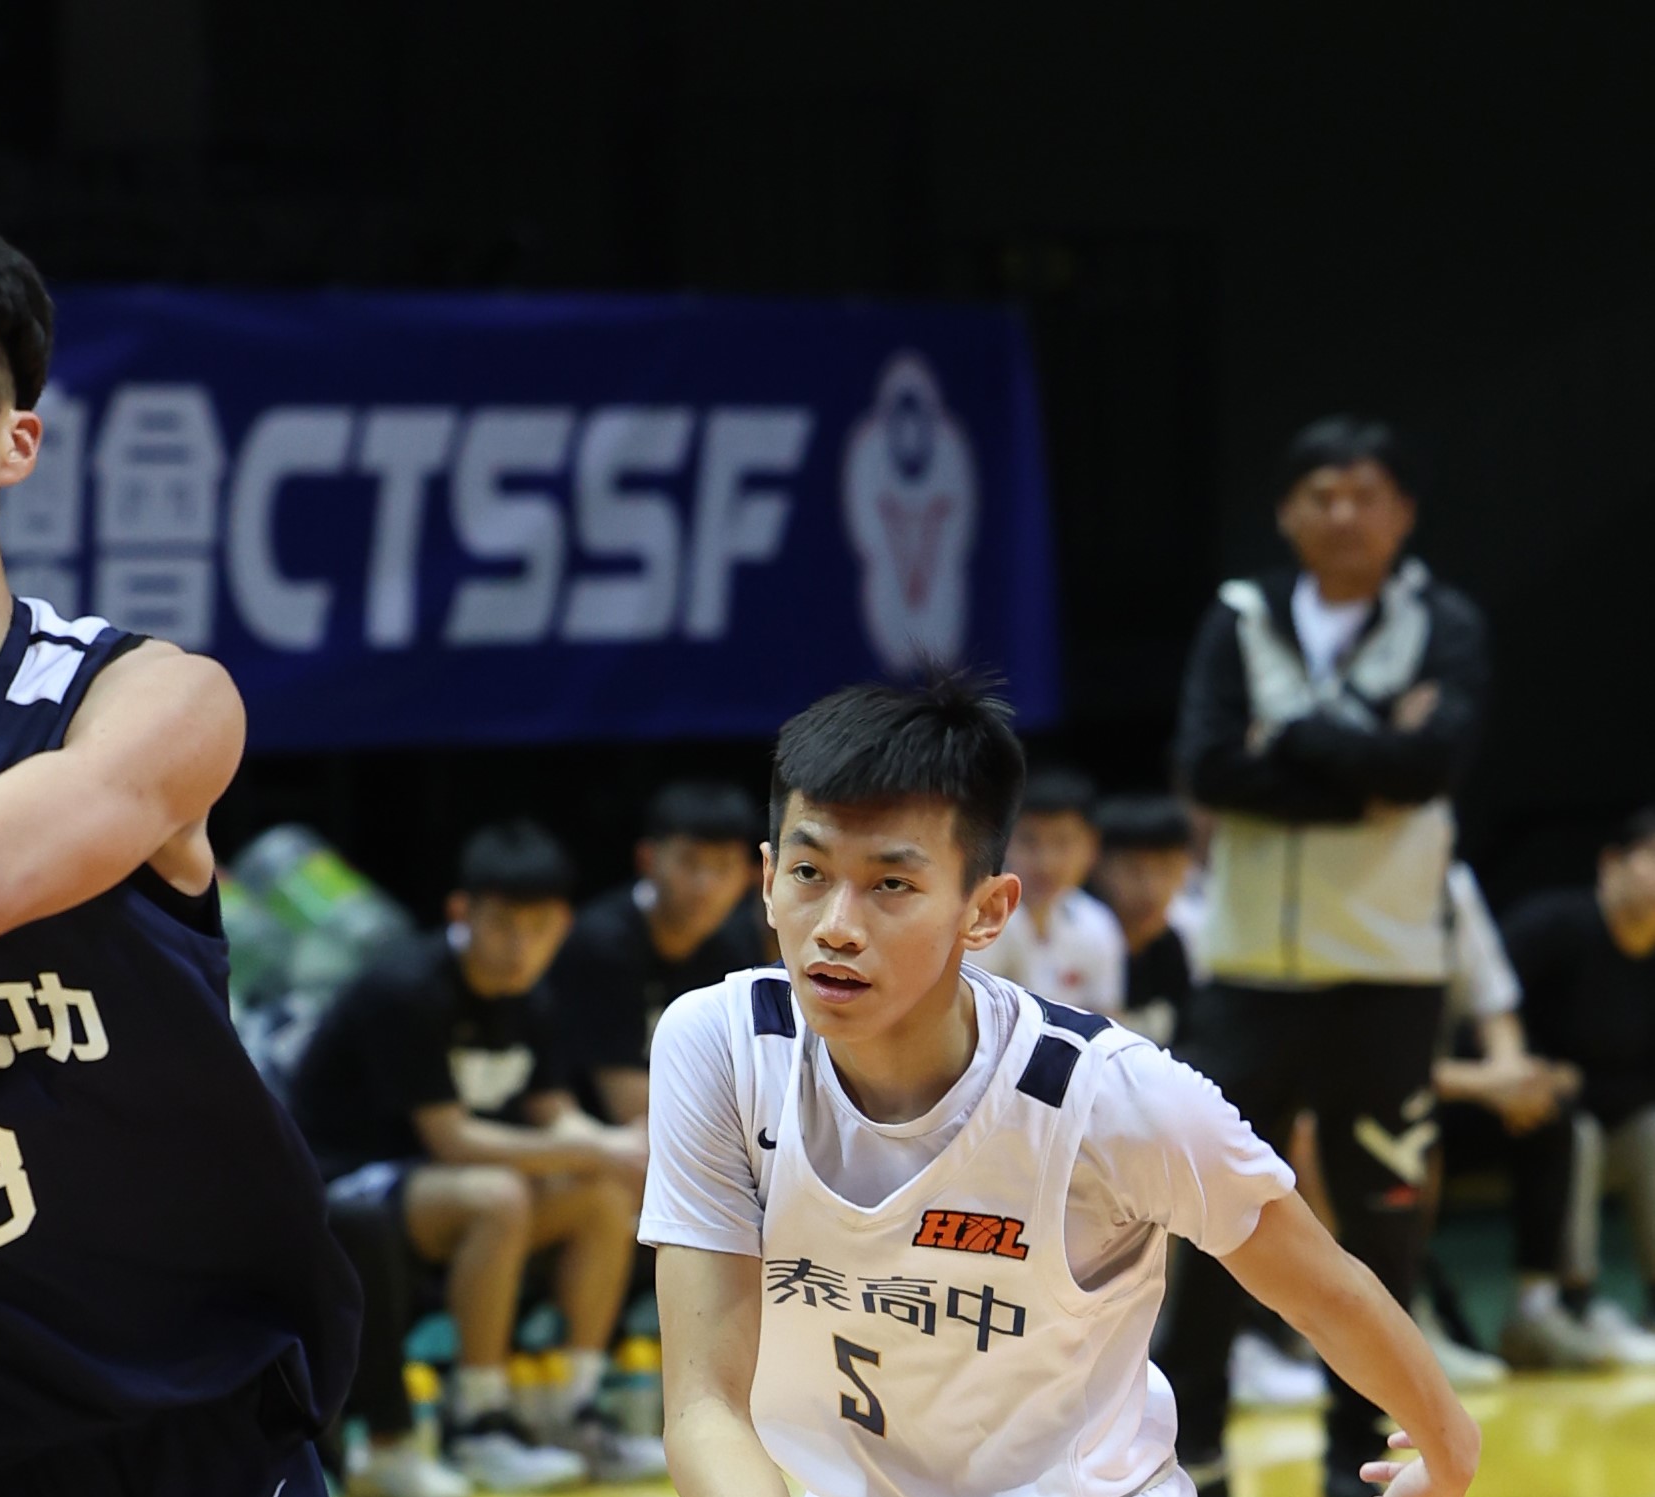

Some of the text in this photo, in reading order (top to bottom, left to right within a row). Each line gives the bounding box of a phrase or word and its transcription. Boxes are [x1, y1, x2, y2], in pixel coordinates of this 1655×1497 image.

[227, 405, 813, 652] CTSSF
[911, 1210, 1029, 1261] HBL
[833, 1332, 888, 1440] 5
